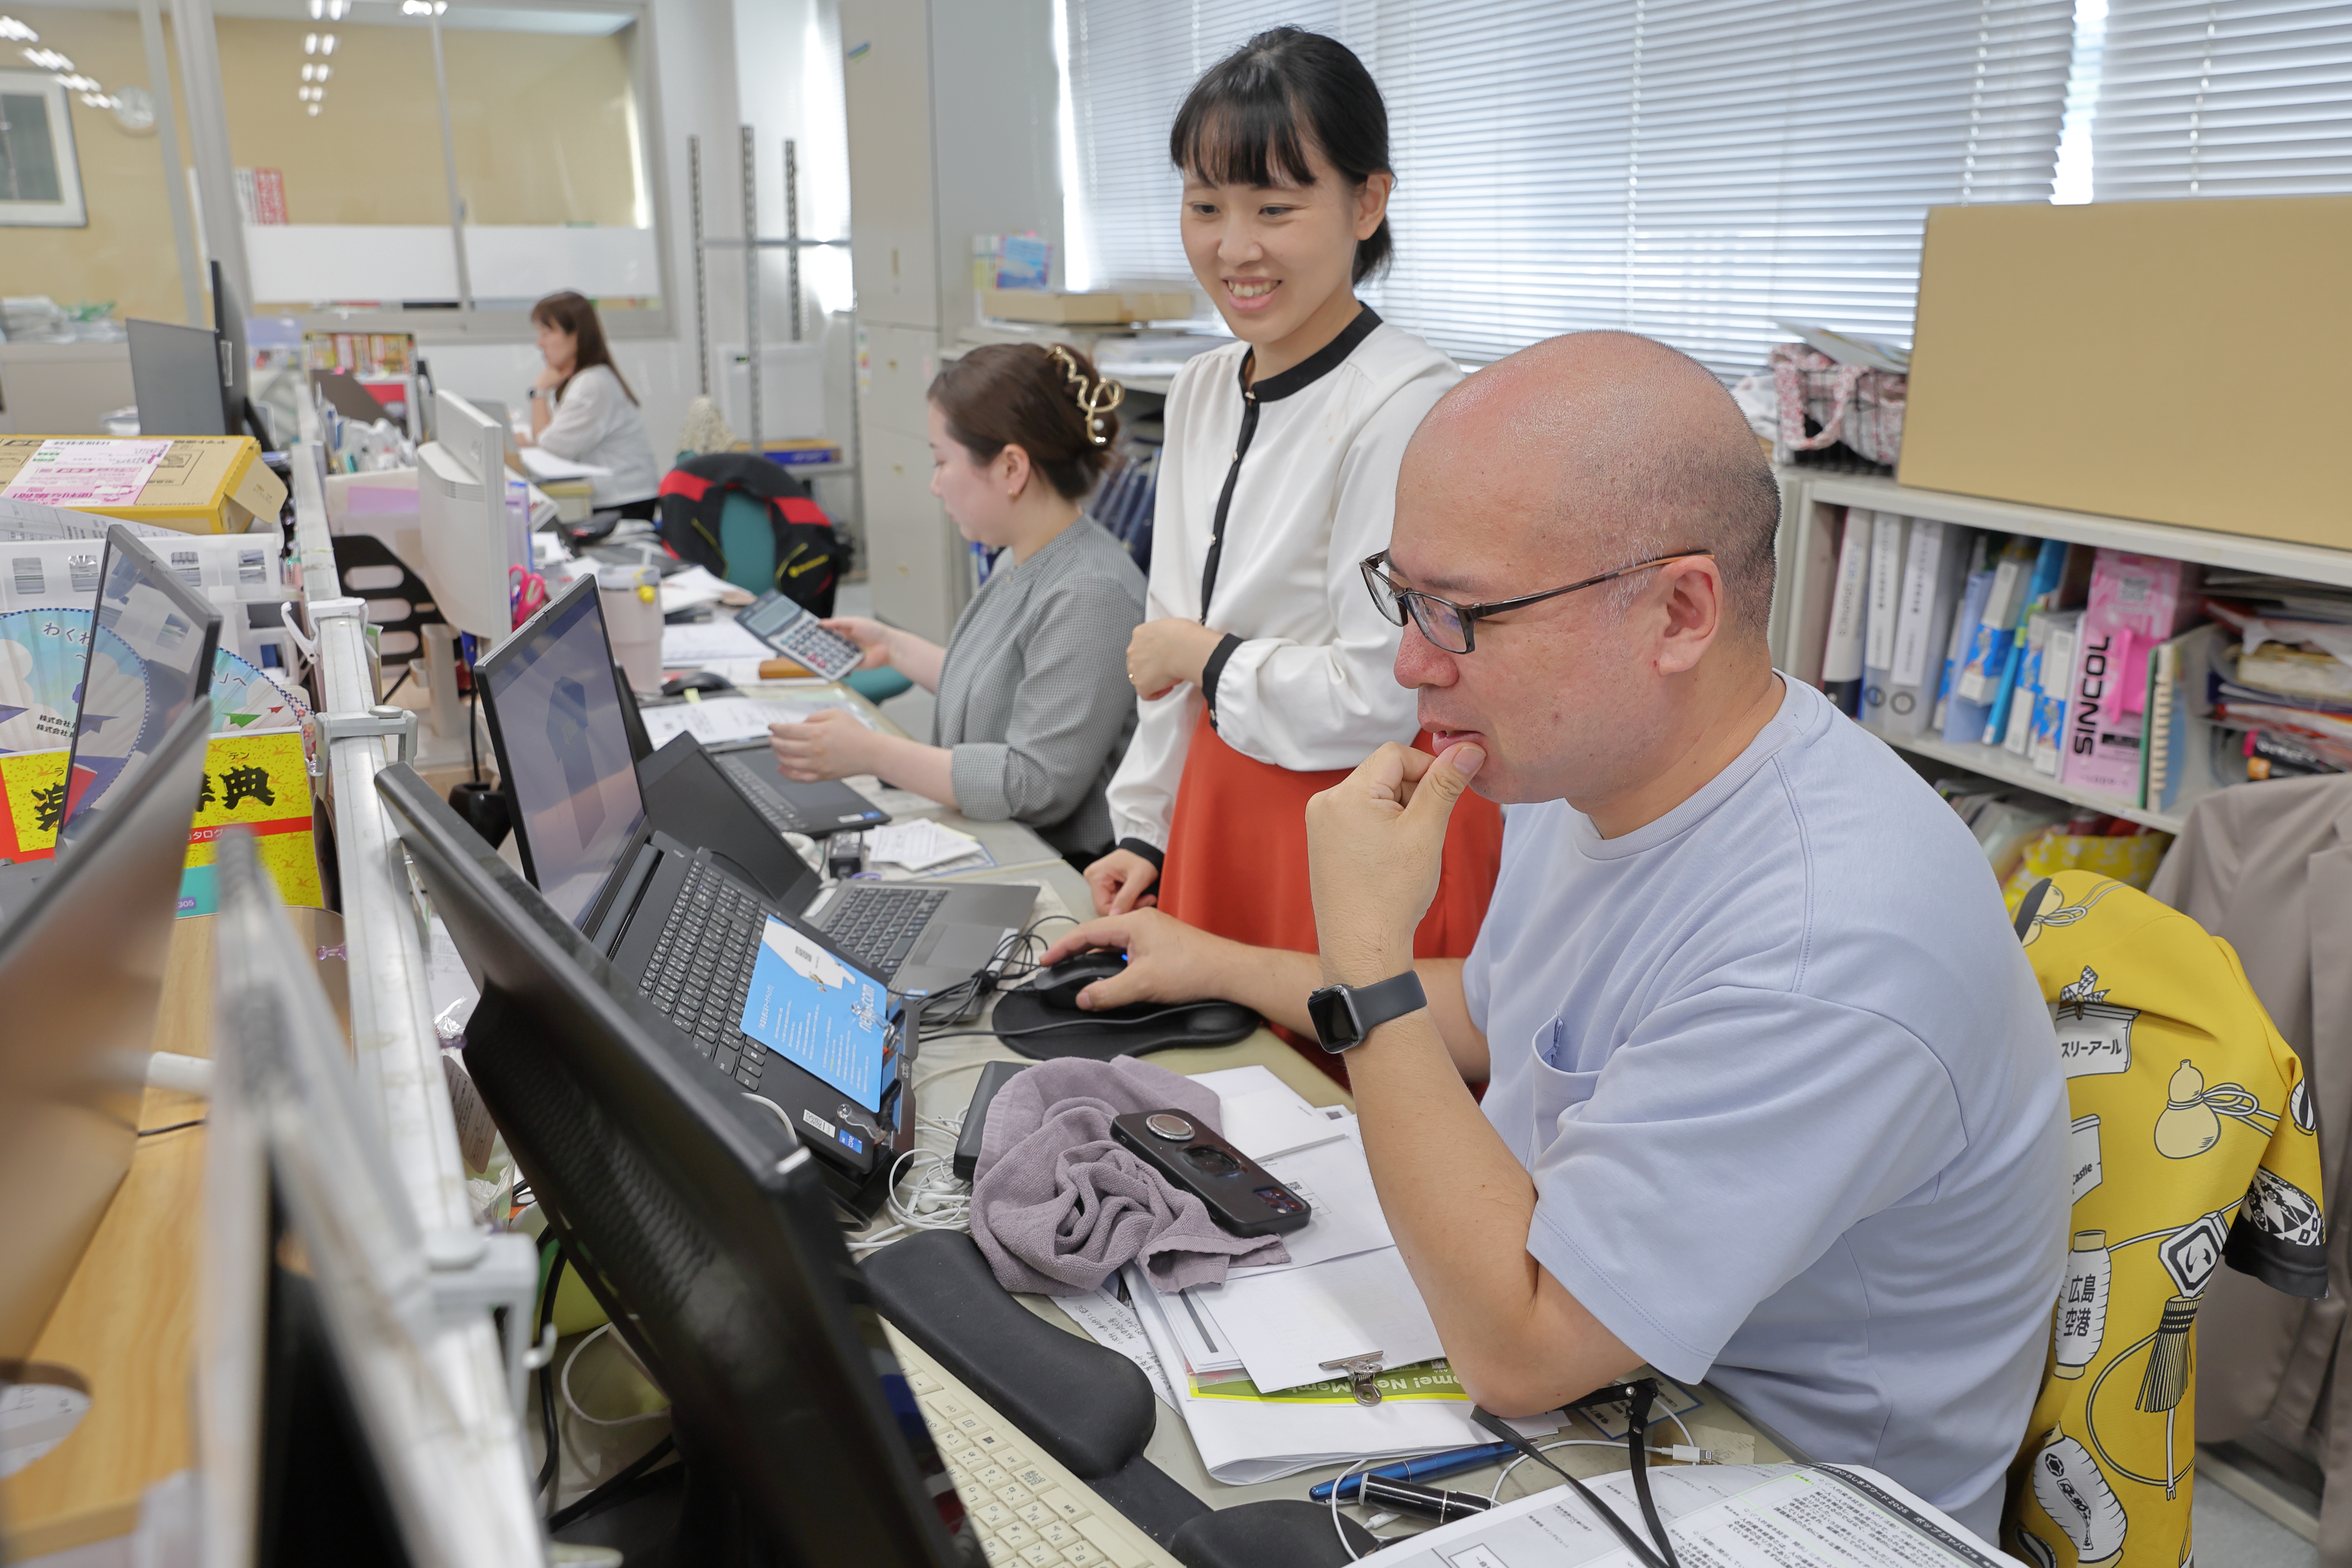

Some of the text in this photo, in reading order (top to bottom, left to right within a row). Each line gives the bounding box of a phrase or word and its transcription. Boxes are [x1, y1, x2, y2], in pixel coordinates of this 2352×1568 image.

[2074, 636, 2110, 755] SINCOL
[39, 714, 76, 729] 株式会社
[229, 752, 250, 760] テン
[188, 828, 224, 841] タログ
[177, 898, 194, 908] 305
[2061, 1038, 2122, 1059] スリーアール
[2068, 1273, 2096, 1304] 広島
[2063, 1307, 2092, 1338] 空港
[1376, 1378, 1408, 1390] Ne
[1027, 1513, 1040, 1521] M
